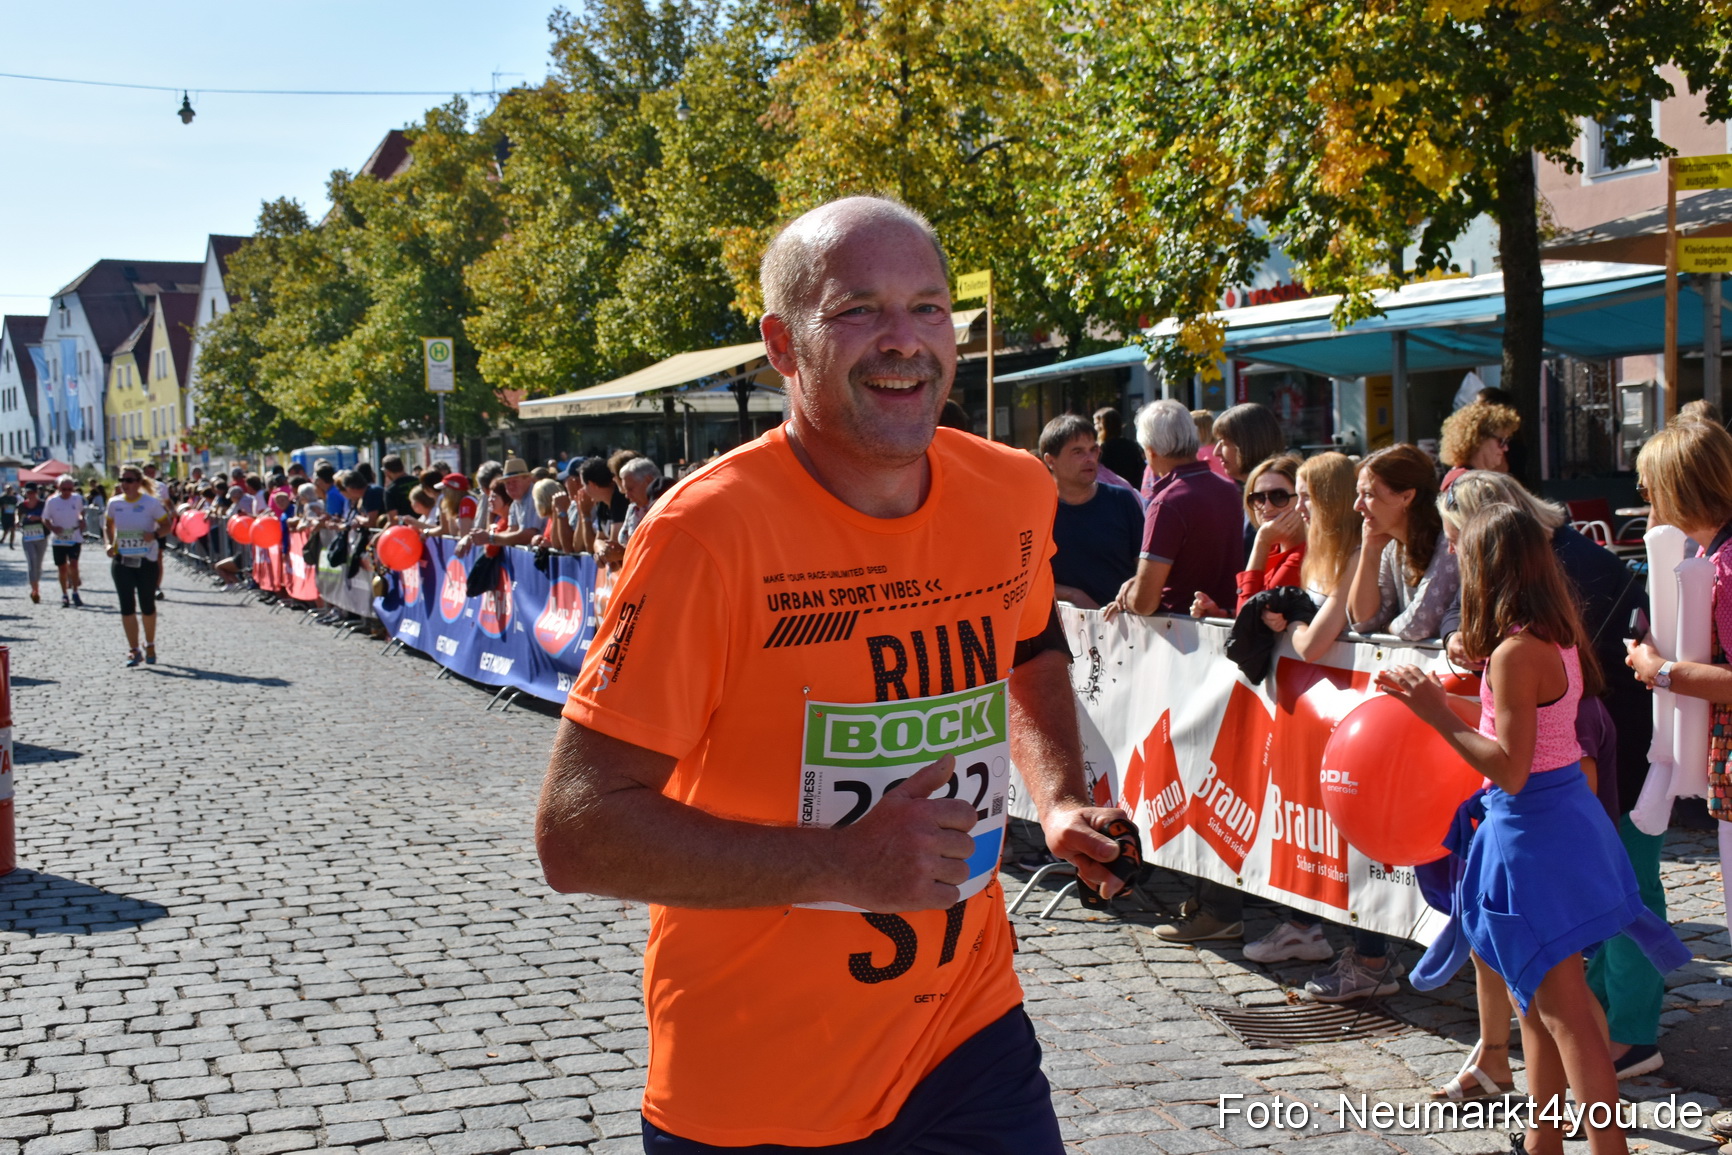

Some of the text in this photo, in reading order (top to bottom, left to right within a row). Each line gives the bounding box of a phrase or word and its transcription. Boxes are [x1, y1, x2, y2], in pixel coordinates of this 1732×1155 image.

[1685, 174, 1719, 188] ausgabe
[1694, 256, 1728, 268] ausgabe
[434, 345, 445, 358] H
[121, 539, 144, 548] 2127
[763, 573, 786, 584] MAKE
[866, 565, 888, 574] SPEED
[767, 589, 825, 612] URBAN
[828, 584, 877, 606] SPORT
[879, 579, 922, 601] VIBES
[624, 621, 636, 646] URBAN
[633, 593, 647, 621] STREET
[592, 601, 637, 692] VIBES
[828, 696, 995, 757] BOCK
[834, 762, 989, 829] 22
[1144, 780, 1183, 829] Braun
[1193, 759, 1256, 842] Braun
[1207, 817, 1248, 859] Sicher ist sicher
[1271, 783, 1339, 860] Braun
[1296, 854, 1349, 884] Sicher ist sicher
[1369, 865, 1416, 887] Fax 09181
[913, 994, 937, 1004] GET
